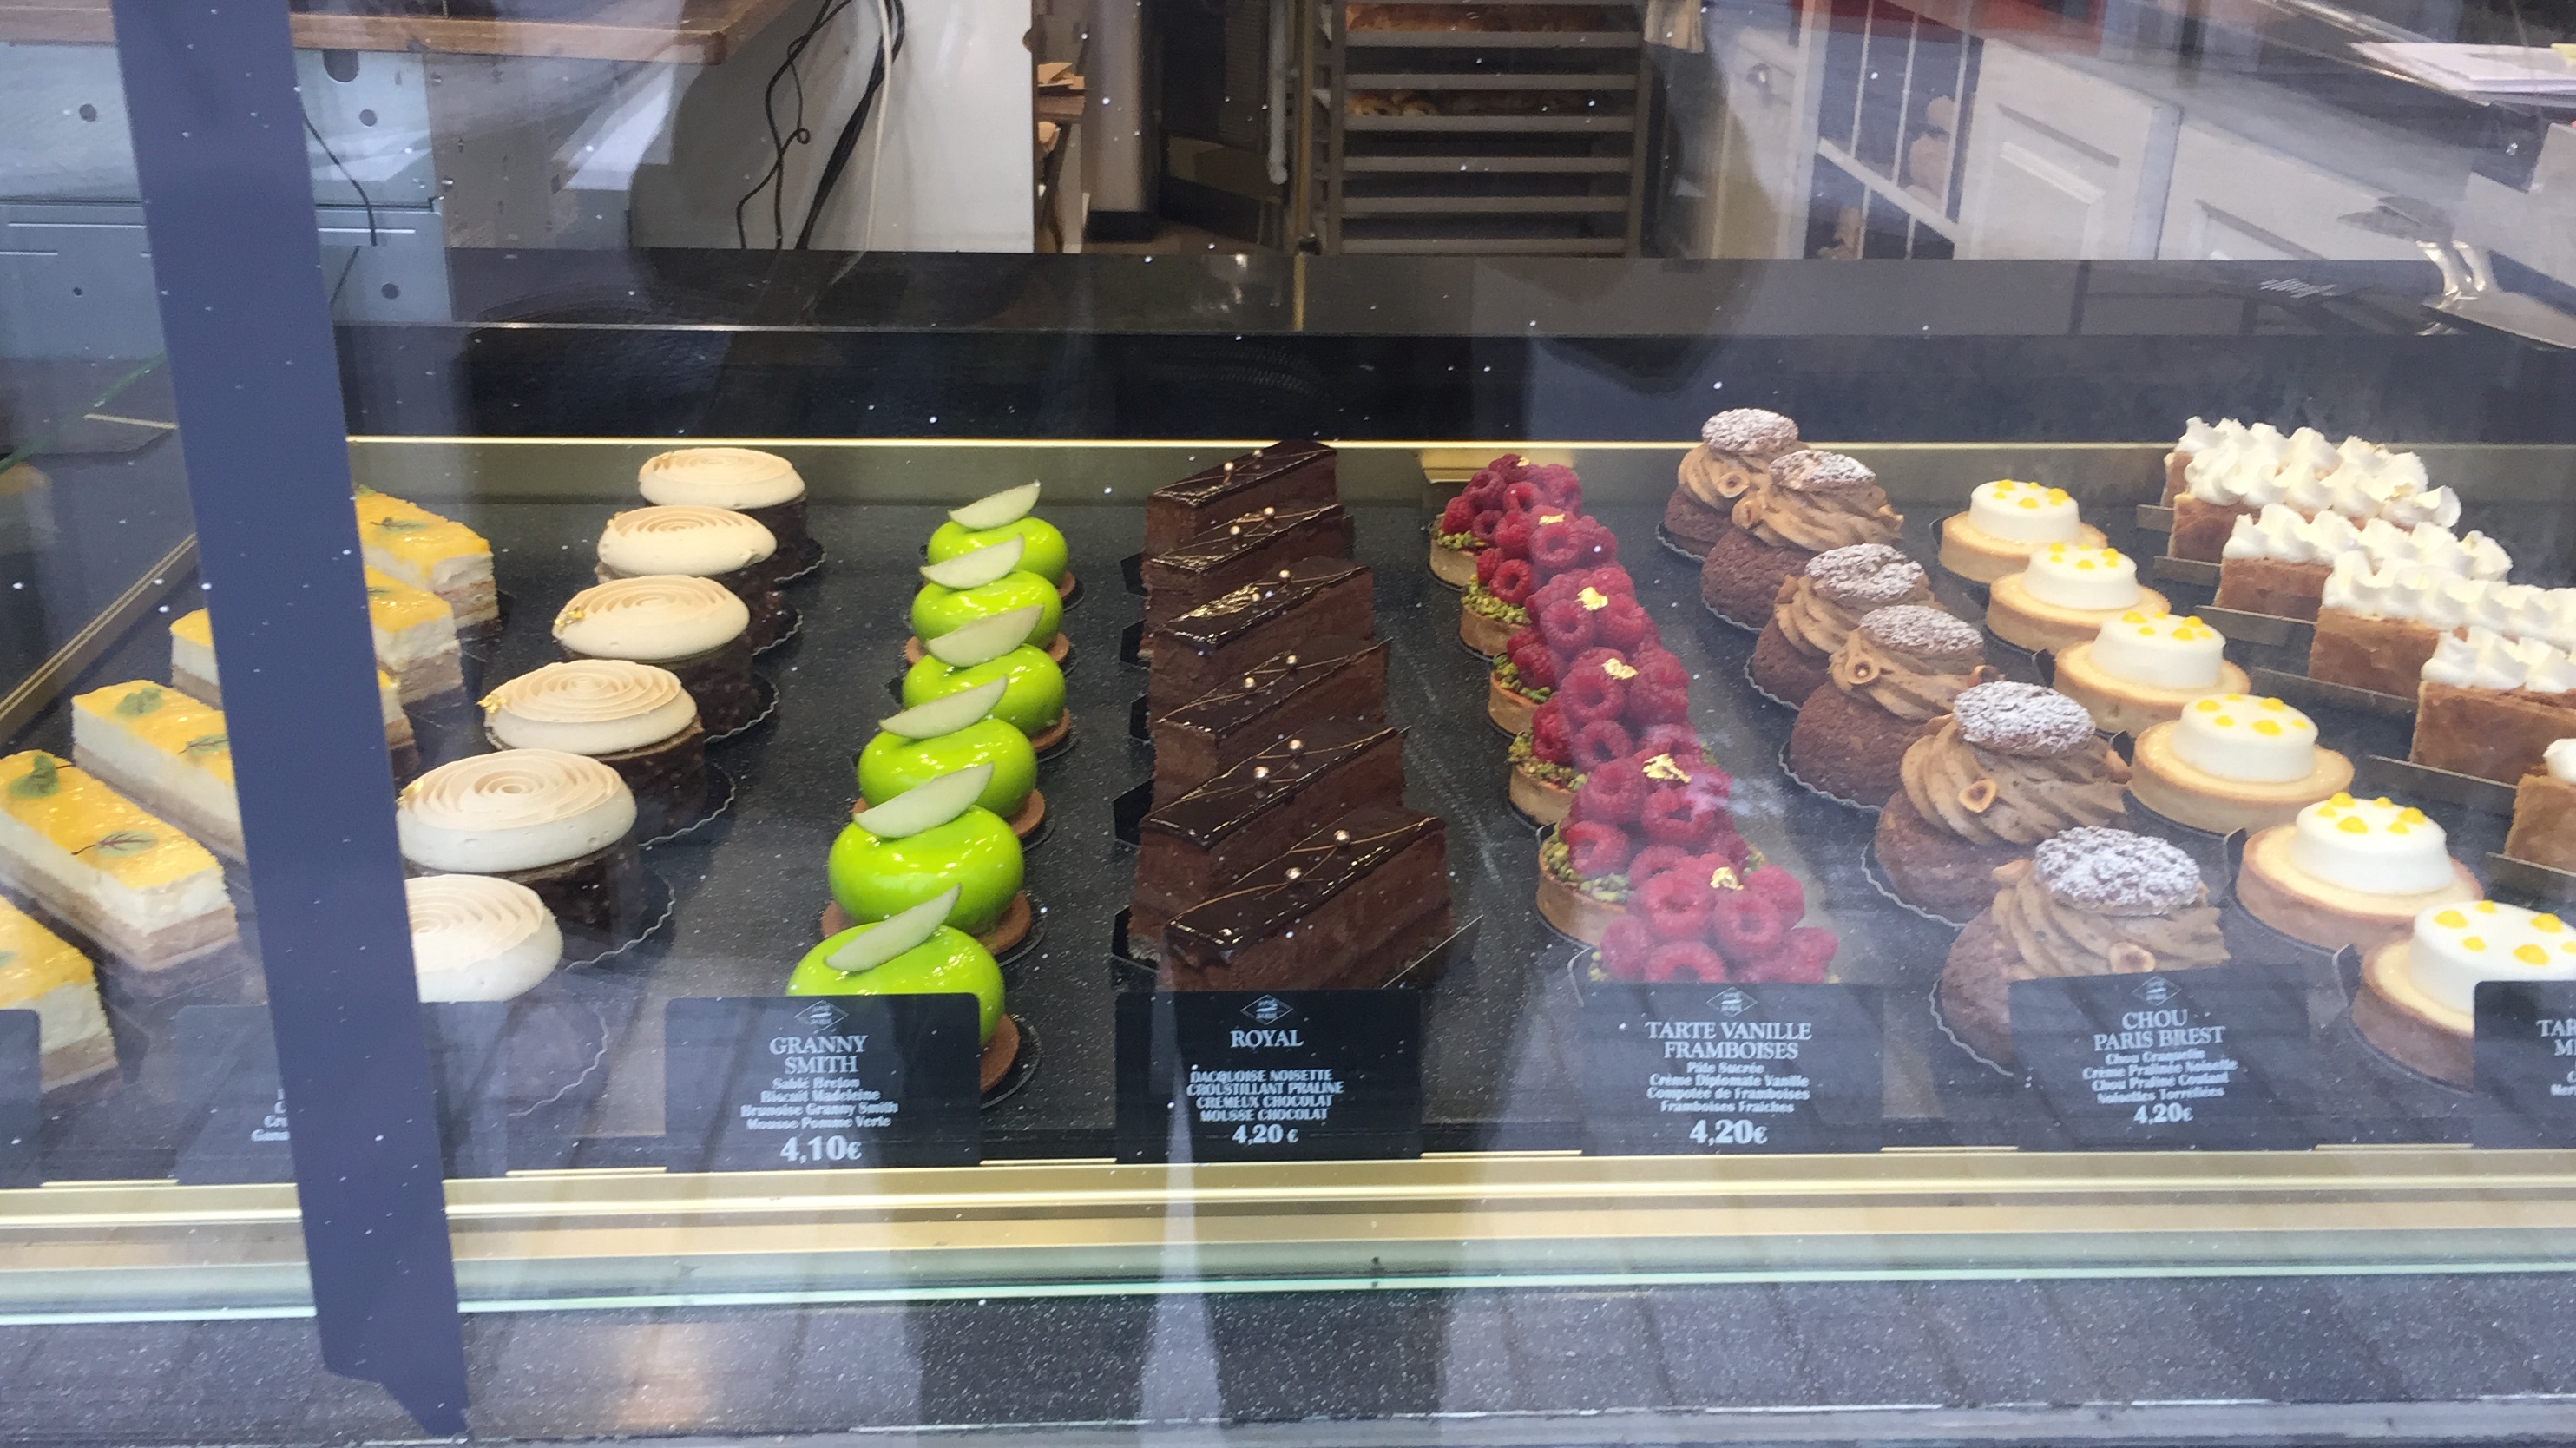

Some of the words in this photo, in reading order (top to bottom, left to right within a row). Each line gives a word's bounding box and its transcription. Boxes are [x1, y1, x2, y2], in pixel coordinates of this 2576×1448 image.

[2121, 1009, 2188, 1030] CHOU
[1645, 1022, 1718, 1039] TARTE
[1720, 1022, 1812, 1040] VANILLE
[2093, 1030, 2154, 1052] PARIS
[2158, 1025, 2226, 1048] BREST
[769, 1034, 868, 1055] GRANNY
[1230, 1029, 1304, 1049] ROYAL
[1663, 1042, 1799, 1059] FRAMBOISES
[784, 1055, 859, 1074] SMITH
[1718, 1060, 1765, 1074] Sucrée
[772, 1076, 811, 1089] Sablé
[813, 1076, 860, 1089] Breton
[1190, 1070, 1266, 1083] DACQUOISE
[1269, 1069, 1333, 1082] NOISETTE
[1649, 1073, 1692, 1086] Crème
[1694, 1073, 1762, 1088] Diplomate
[1764, 1074, 1810, 1088] Vanille
[760, 1089, 809, 1103] Biscuit
[812, 1088, 881, 1102] Madeleine
[1186, 1083, 1284, 1096] CROUSTILLANT
[1714, 1087, 1732, 1100] de
[1734, 1086, 1810, 1100] Framboises
[740, 1104, 804, 1117] Brunoise
[805, 1102, 857, 1117] Granny
[858, 1101, 899, 1114] Smith
[1262, 1095, 1333, 1108] CHOCOLAT
[1659, 1099, 1736, 1112] Framboises
[746, 1117, 799, 1130] Mousse
[801, 1116, 853, 1129] Pomme
[855, 1115, 892, 1128] Verte
[1200, 1109, 1256, 1122] MOUSSE
[1257, 1108, 1329, 1121] CHOCOLAT
[1232, 1123, 1284, 1146] 4,20
[1286, 1129, 1299, 1143] €
[1689, 1118, 1768, 1146] 4,20€
[779, 1135, 863, 1164] 4,10€
